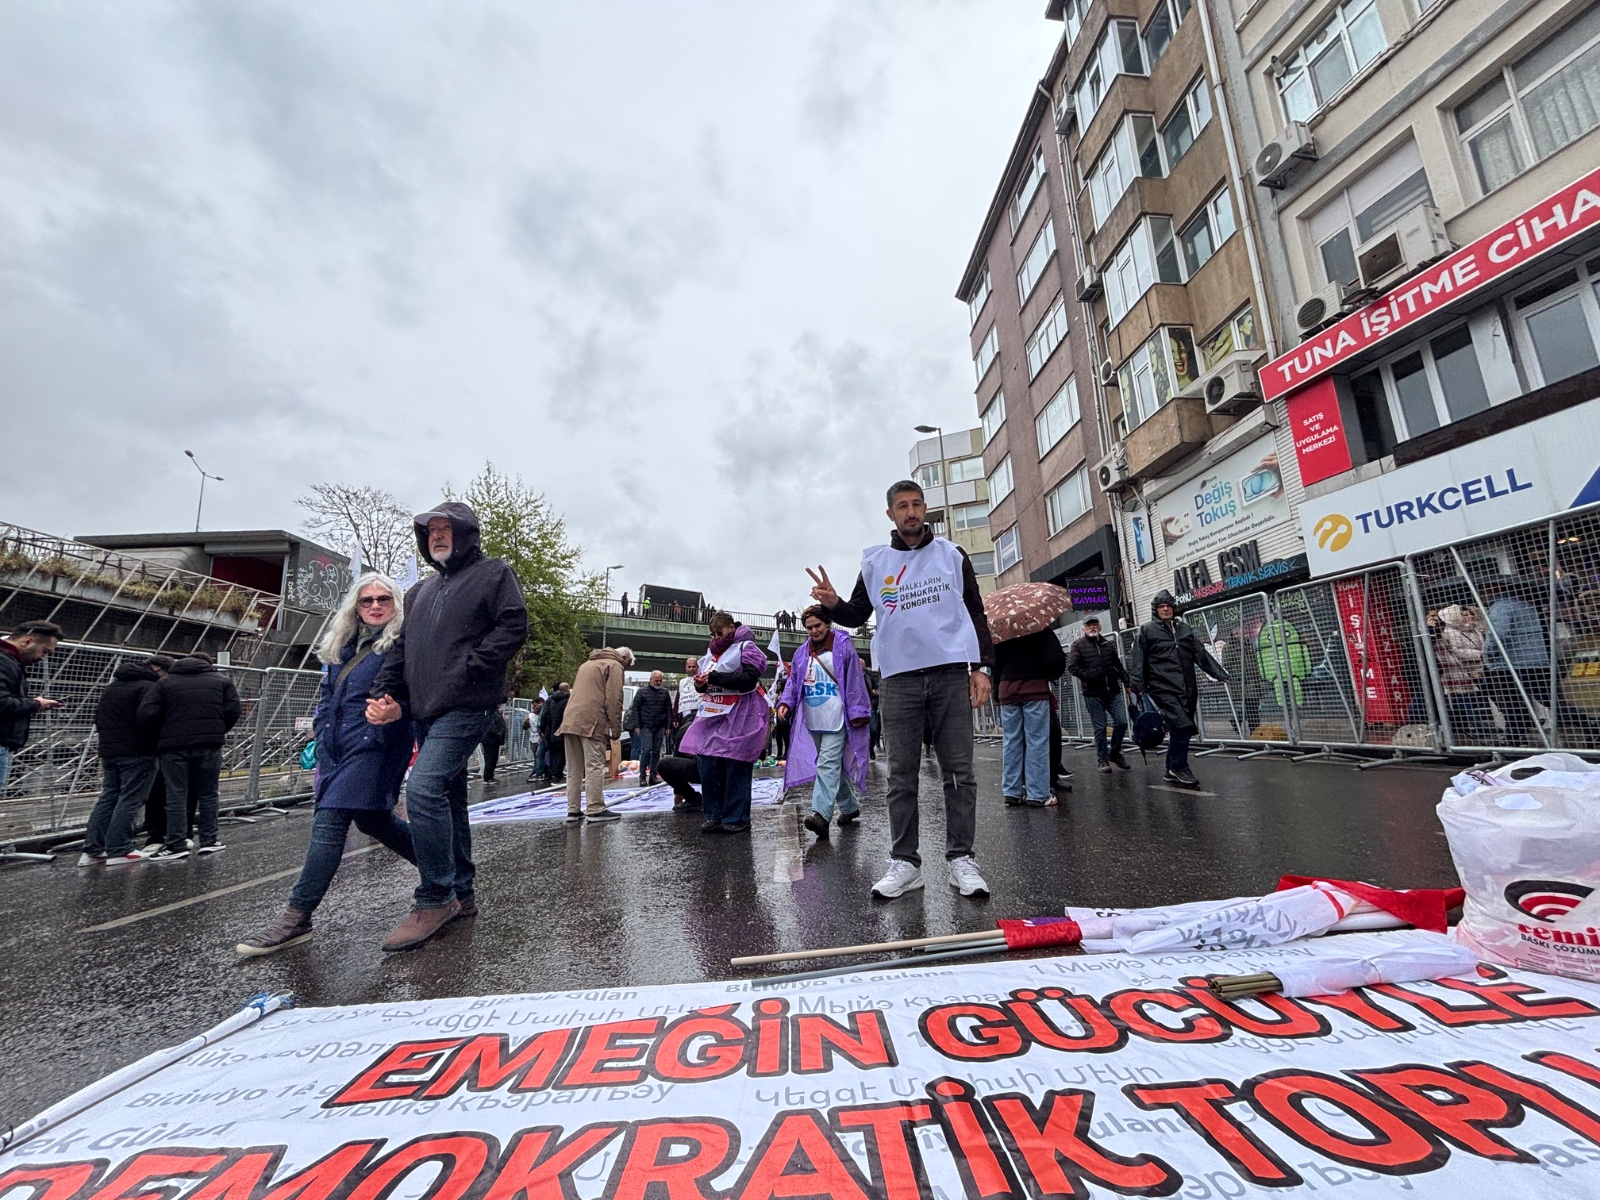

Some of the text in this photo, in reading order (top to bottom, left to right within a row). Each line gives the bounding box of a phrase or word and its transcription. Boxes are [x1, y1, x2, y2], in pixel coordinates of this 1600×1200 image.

[1277, 332, 1358, 383] TUNA
[1364, 258, 1480, 340] İŞİTME
[1302, 412, 1324, 426] SATIŞ
[1309, 423, 1321, 431] VE
[1296, 424, 1339, 447] UYGULAMA
[1302, 433, 1336, 454] MERKEZİ
[1194, 480, 1233, 511] Değiş
[1355, 468, 1533, 534] TURKCELL
[1196, 499, 1237, 528] Tokuş
[1174, 540, 1262, 598] ALFA GSM
[899, 576, 941, 593] HALKLARIN
[900, 583, 951, 602] DEMOKRATİK
[901, 593, 940, 611] KONGRESİ
[1073, 596, 1107, 604] KAYNAK
[806, 682, 838, 697] ESK
[1517, 923, 1600, 947] cemi
[1521, 933, 1550, 949] BASKI
[321, 997, 899, 1108] EMEĞİN
